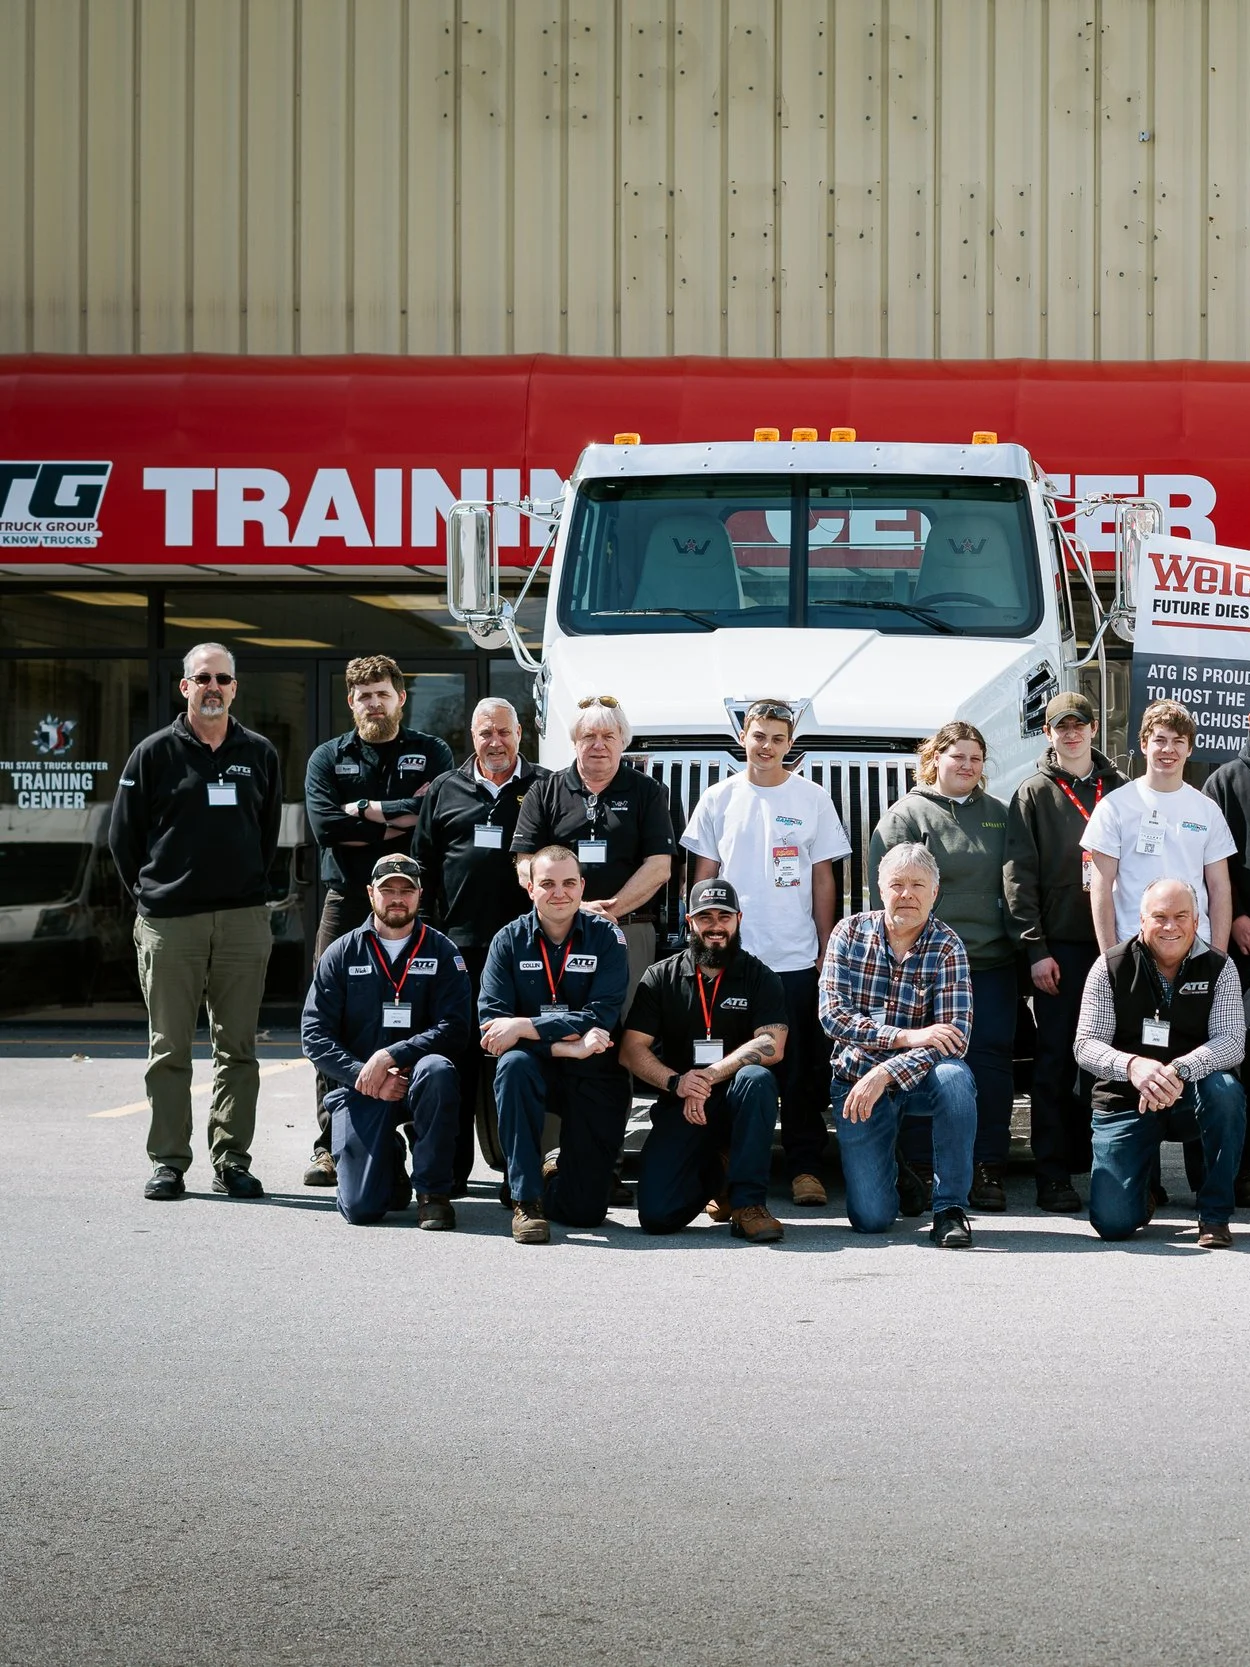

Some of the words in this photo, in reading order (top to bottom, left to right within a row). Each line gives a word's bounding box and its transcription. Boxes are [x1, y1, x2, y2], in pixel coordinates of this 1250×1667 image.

[143, 467, 564, 547] TRAINI
[46, 522, 95, 532] GROUP
[3, 536, 39, 545] KNOW
[1152, 599, 1210, 617] FUTURE
[1147, 664, 1177, 680] ATG
[1182, 666, 1198, 682] IS
[1146, 686, 1166, 701] TO
[1171, 687, 1213, 704] HOST
[1217, 690, 1246, 708] THE
[1191, 711, 1250, 730] ACHUSE
[0, 762, 14, 770] TRI
[16, 762, 41, 770] STATE
[44, 762, 73, 770] TRUCK
[74, 762, 108, 770] CENTER
[11, 773, 93, 790] TRAINING
[18, 791, 86, 809] CENTER
[700, 888, 727, 898] ATG
[410, 960, 437, 969] ATG
[567, 957, 596, 967] ATG
[1180, 981, 1209, 991] ATG
[721, 997, 748, 1007] ATG
